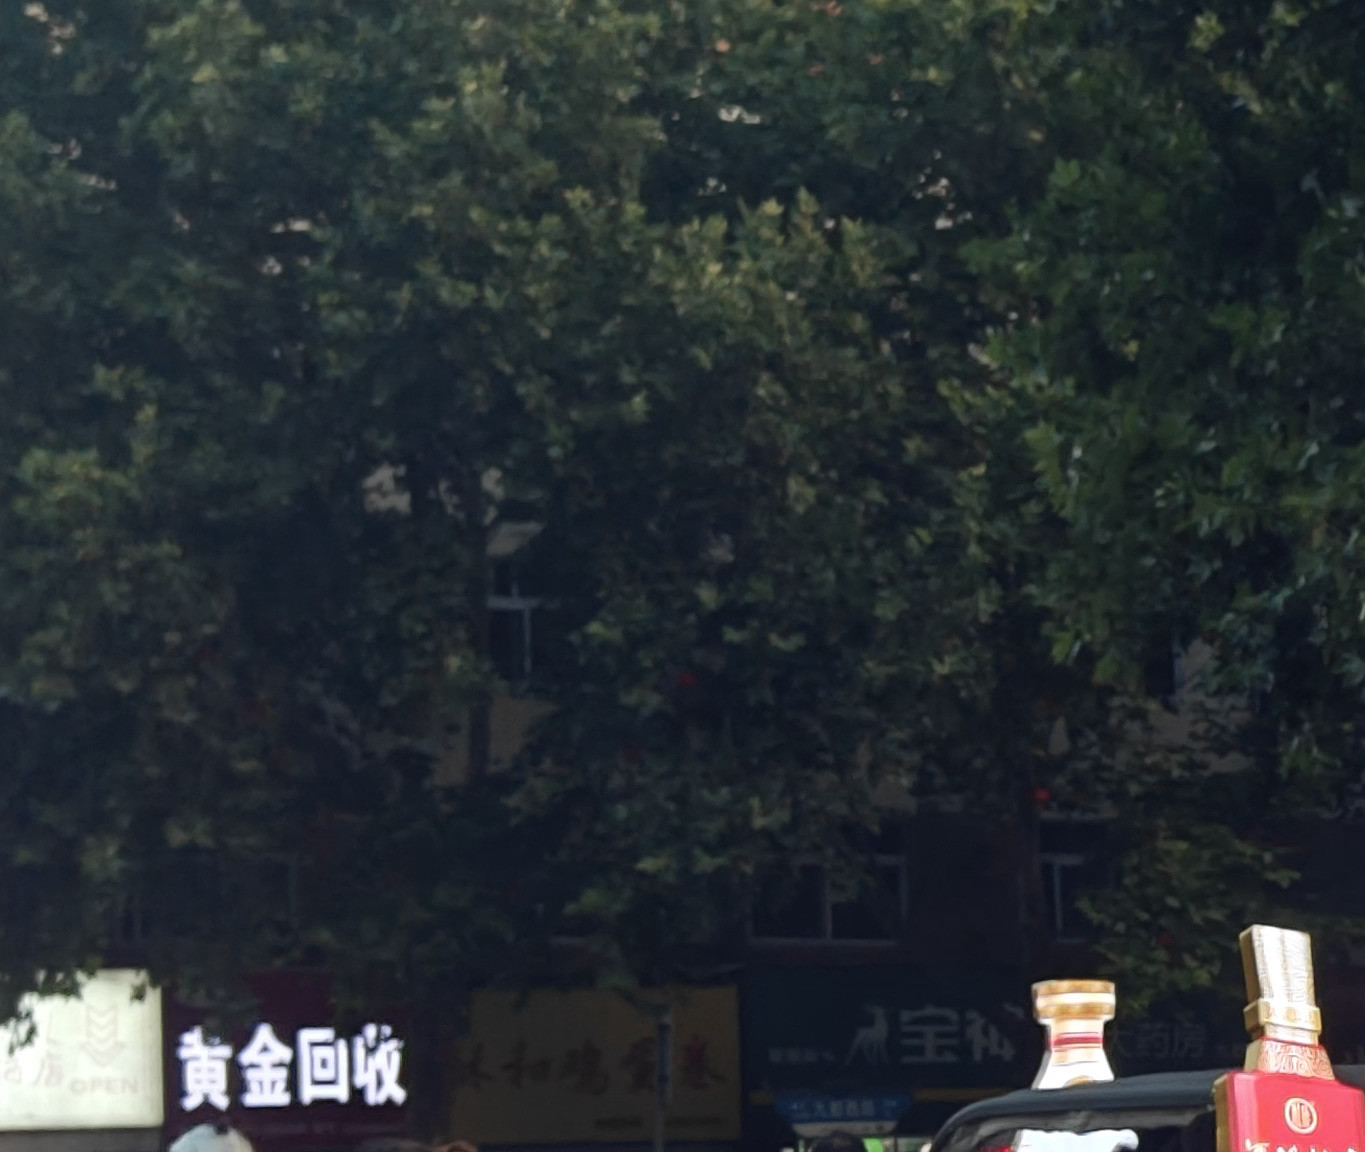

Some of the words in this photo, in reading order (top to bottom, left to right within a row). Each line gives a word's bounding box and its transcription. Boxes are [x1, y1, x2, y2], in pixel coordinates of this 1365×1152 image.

[69, 1076, 139, 1096] OPEN
[176, 1022, 408, 1112] 黄金回收
